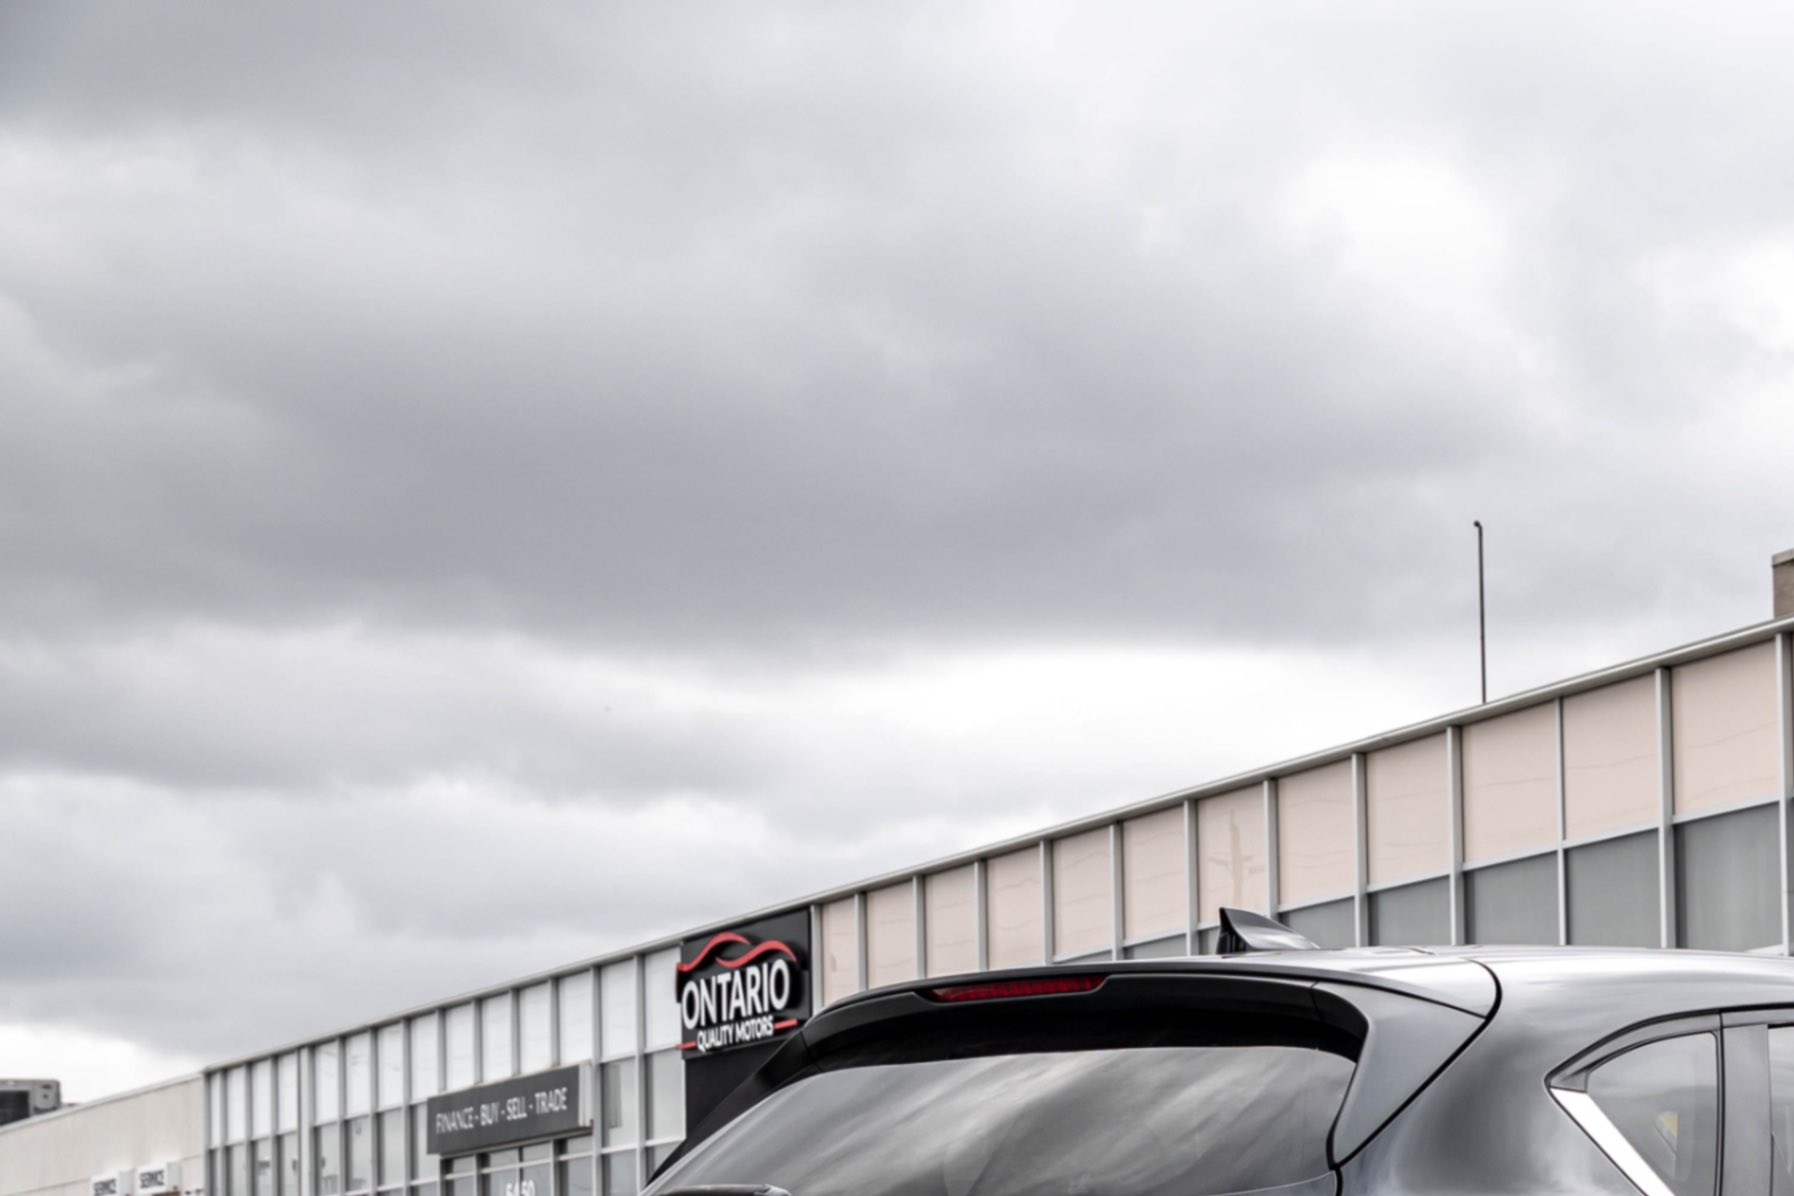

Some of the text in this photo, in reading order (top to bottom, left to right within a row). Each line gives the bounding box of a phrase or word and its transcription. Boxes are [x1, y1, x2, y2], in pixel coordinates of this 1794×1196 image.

[682, 958, 790, 1030] ONTARIO
[697, 1015, 774, 1053] QUALITY MOTORS
[436, 1086, 568, 1134] FINANCE BUY SELL TRADE
